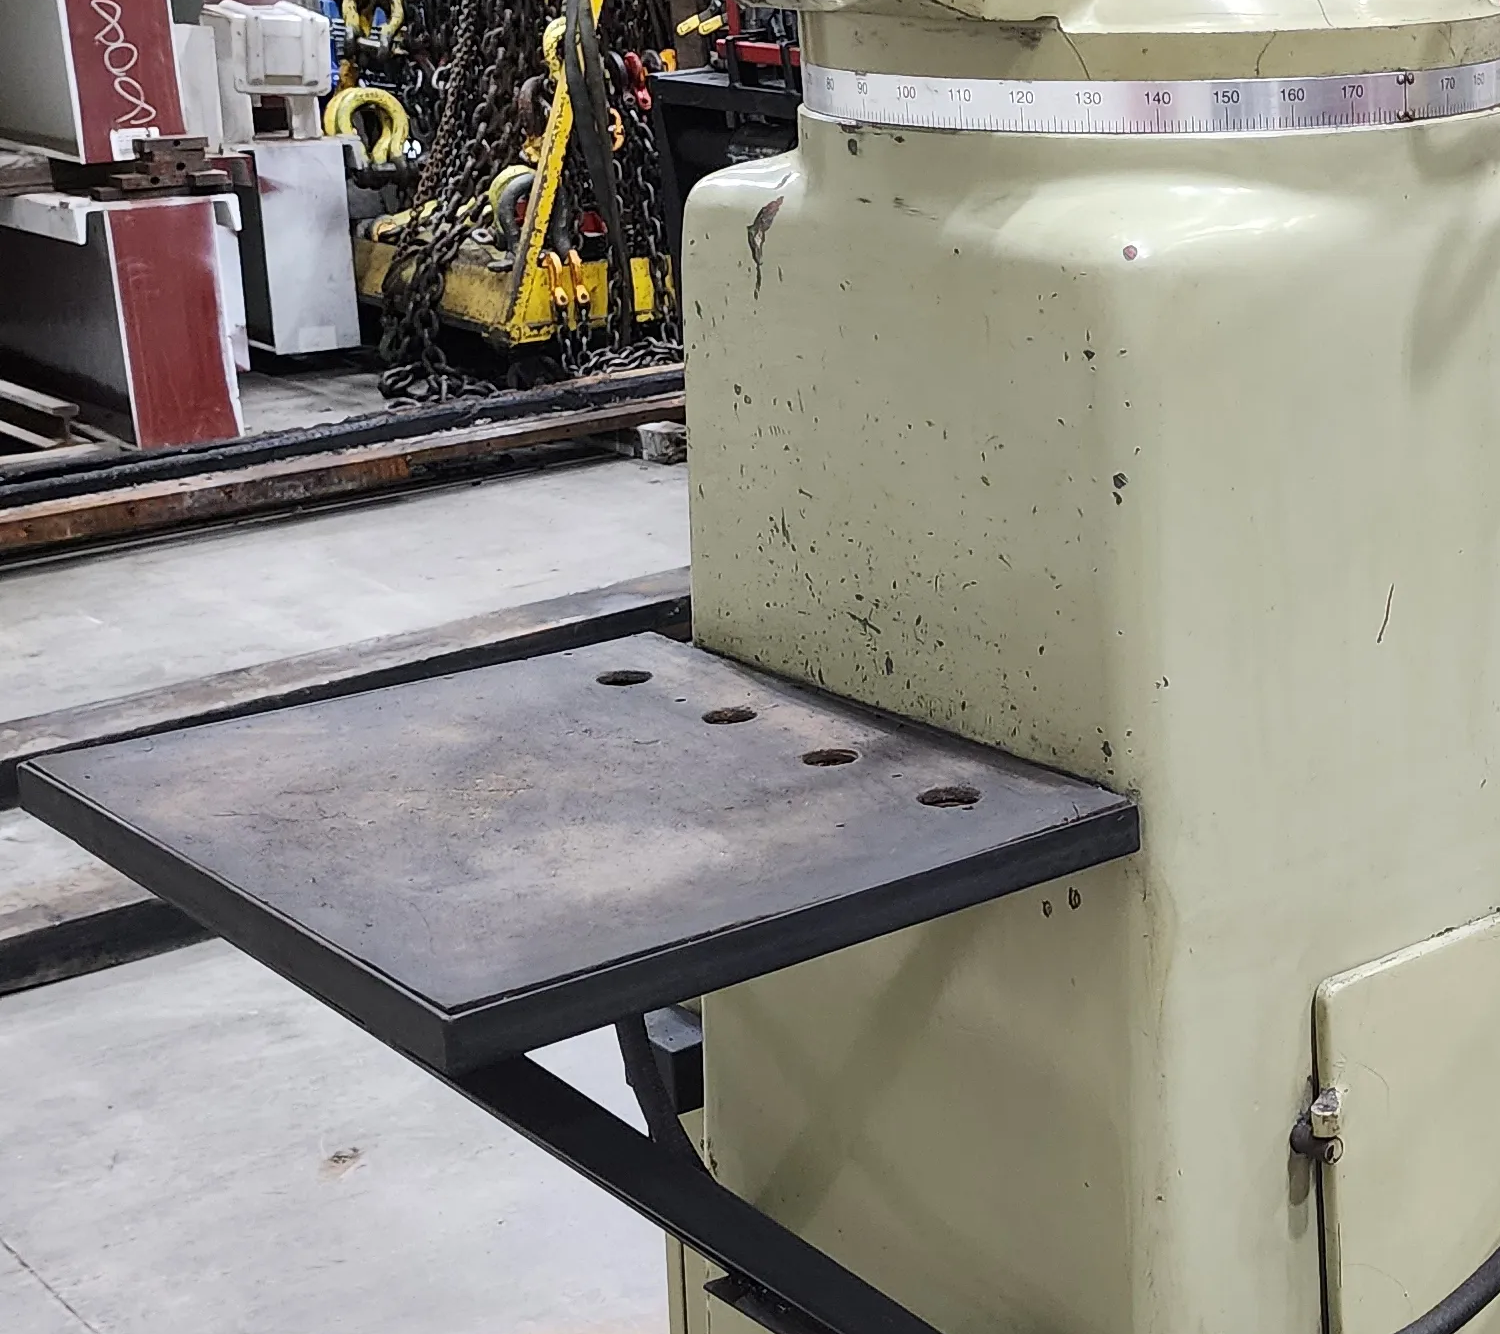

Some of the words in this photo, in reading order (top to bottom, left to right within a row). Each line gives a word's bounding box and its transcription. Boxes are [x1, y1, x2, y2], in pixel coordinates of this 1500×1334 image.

[826, 77, 835, 91] 80
[857, 82, 868, 95] 90
[897, 85, 916, 99] 100
[949, 88, 972, 102] 110
[1009, 90, 1034, 105] 120
[1075, 91, 1102, 105] 130
[1144, 91, 1171, 105] 140
[1213, 90, 1240, 104] 150
[1280, 88, 1305, 102] 160
[1341, 84, 1364, 99] 170
[1440, 77, 1456, 90] 170
